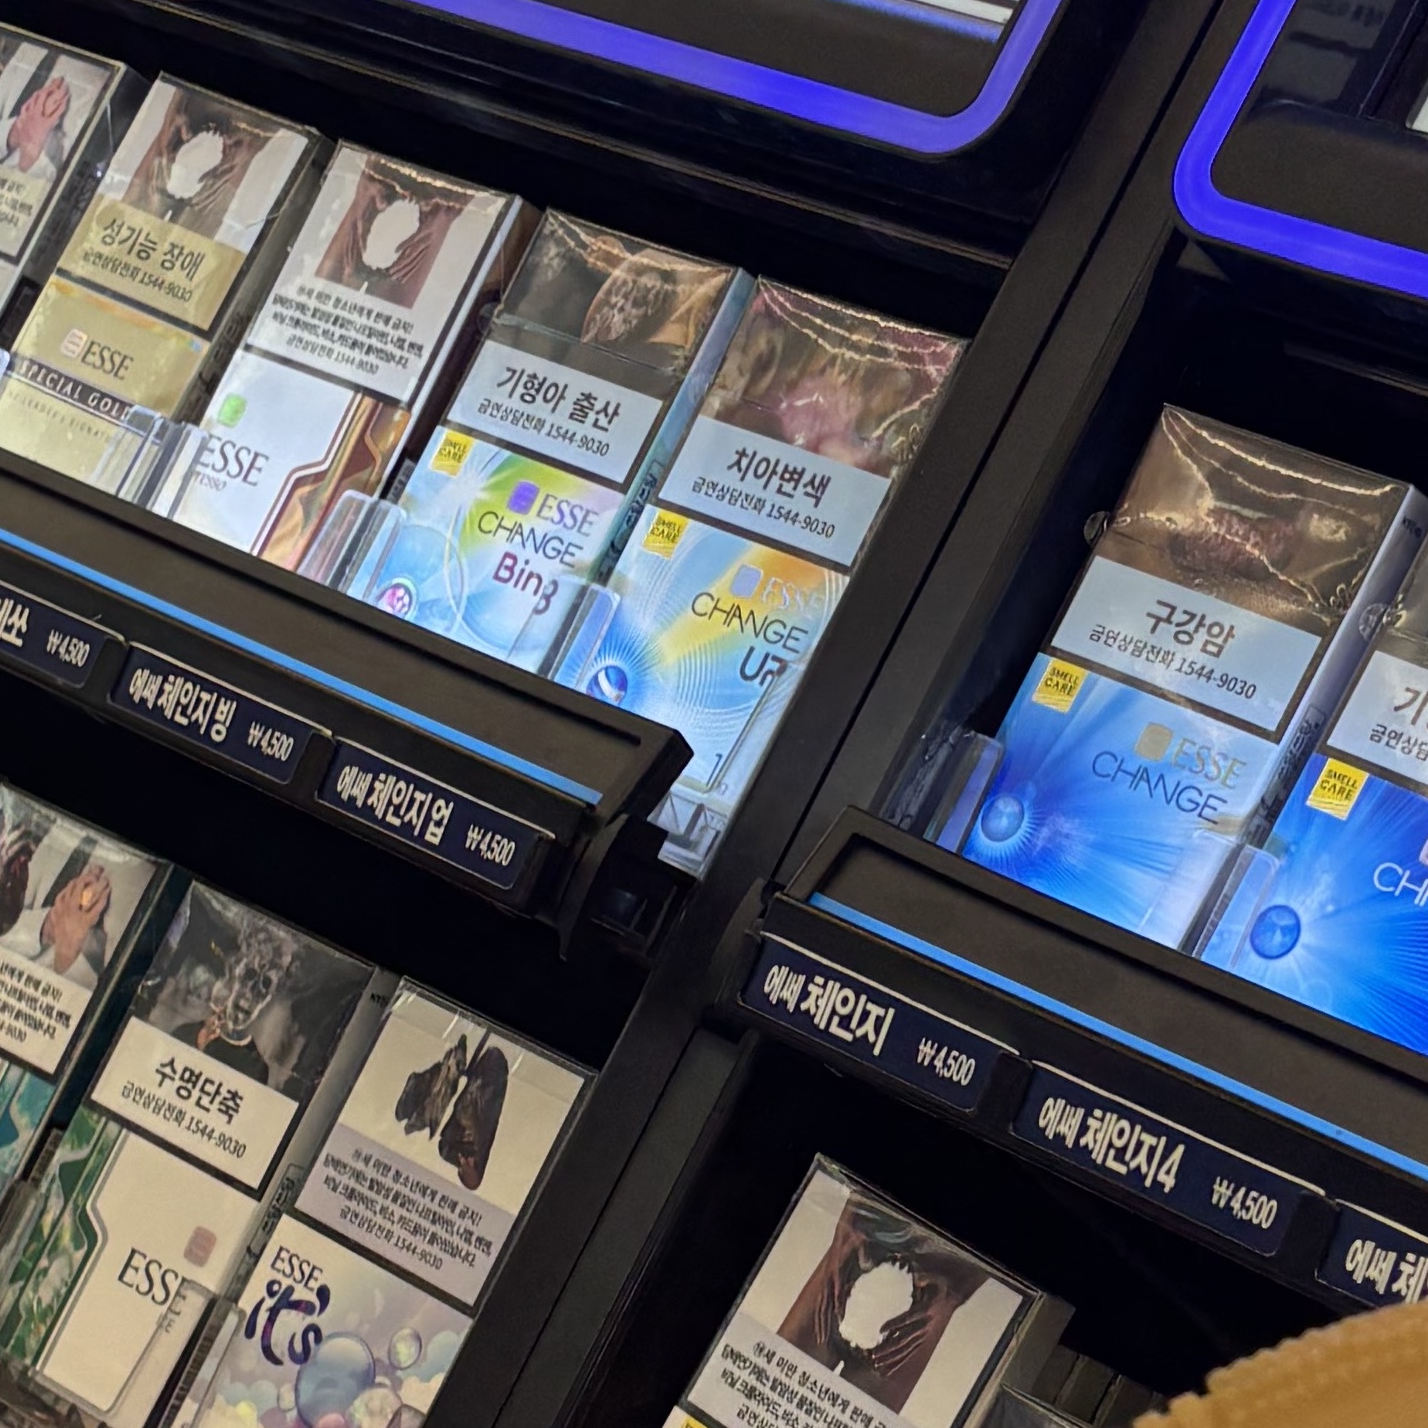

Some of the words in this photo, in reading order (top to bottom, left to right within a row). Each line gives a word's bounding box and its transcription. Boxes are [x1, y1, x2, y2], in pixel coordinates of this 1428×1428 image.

[495, 365, 568, 415] 기형아
[566, 389, 624, 433] 출산
[726, 444, 836, 509] 치아변색
[477, 509, 585, 570] CHANGE
[492, 552, 560, 616] Bing
[1143, 596, 1238, 658] 구강암
[1087, 622, 1178, 672] 금연상담전화
[1174, 652, 1260, 702] 1544-9030
[1090, 750, 1231, 828] CHANGE
[1171, 735, 1250, 794] ESSE
[762, 961, 807, 1012] 에쎄
[801, 974, 896, 1058] 체인지
[914, 1036, 977, 1089] ₩4,500
[153, 1056, 245, 1126] 수명단축
[1037, 1094, 1081, 1134] 에쎄
[1078, 1110, 1184, 1193] 체인지4
[1211, 1176, 1280, 1230] ₩4,500
[269, 1244, 325, 1293] ESSE
